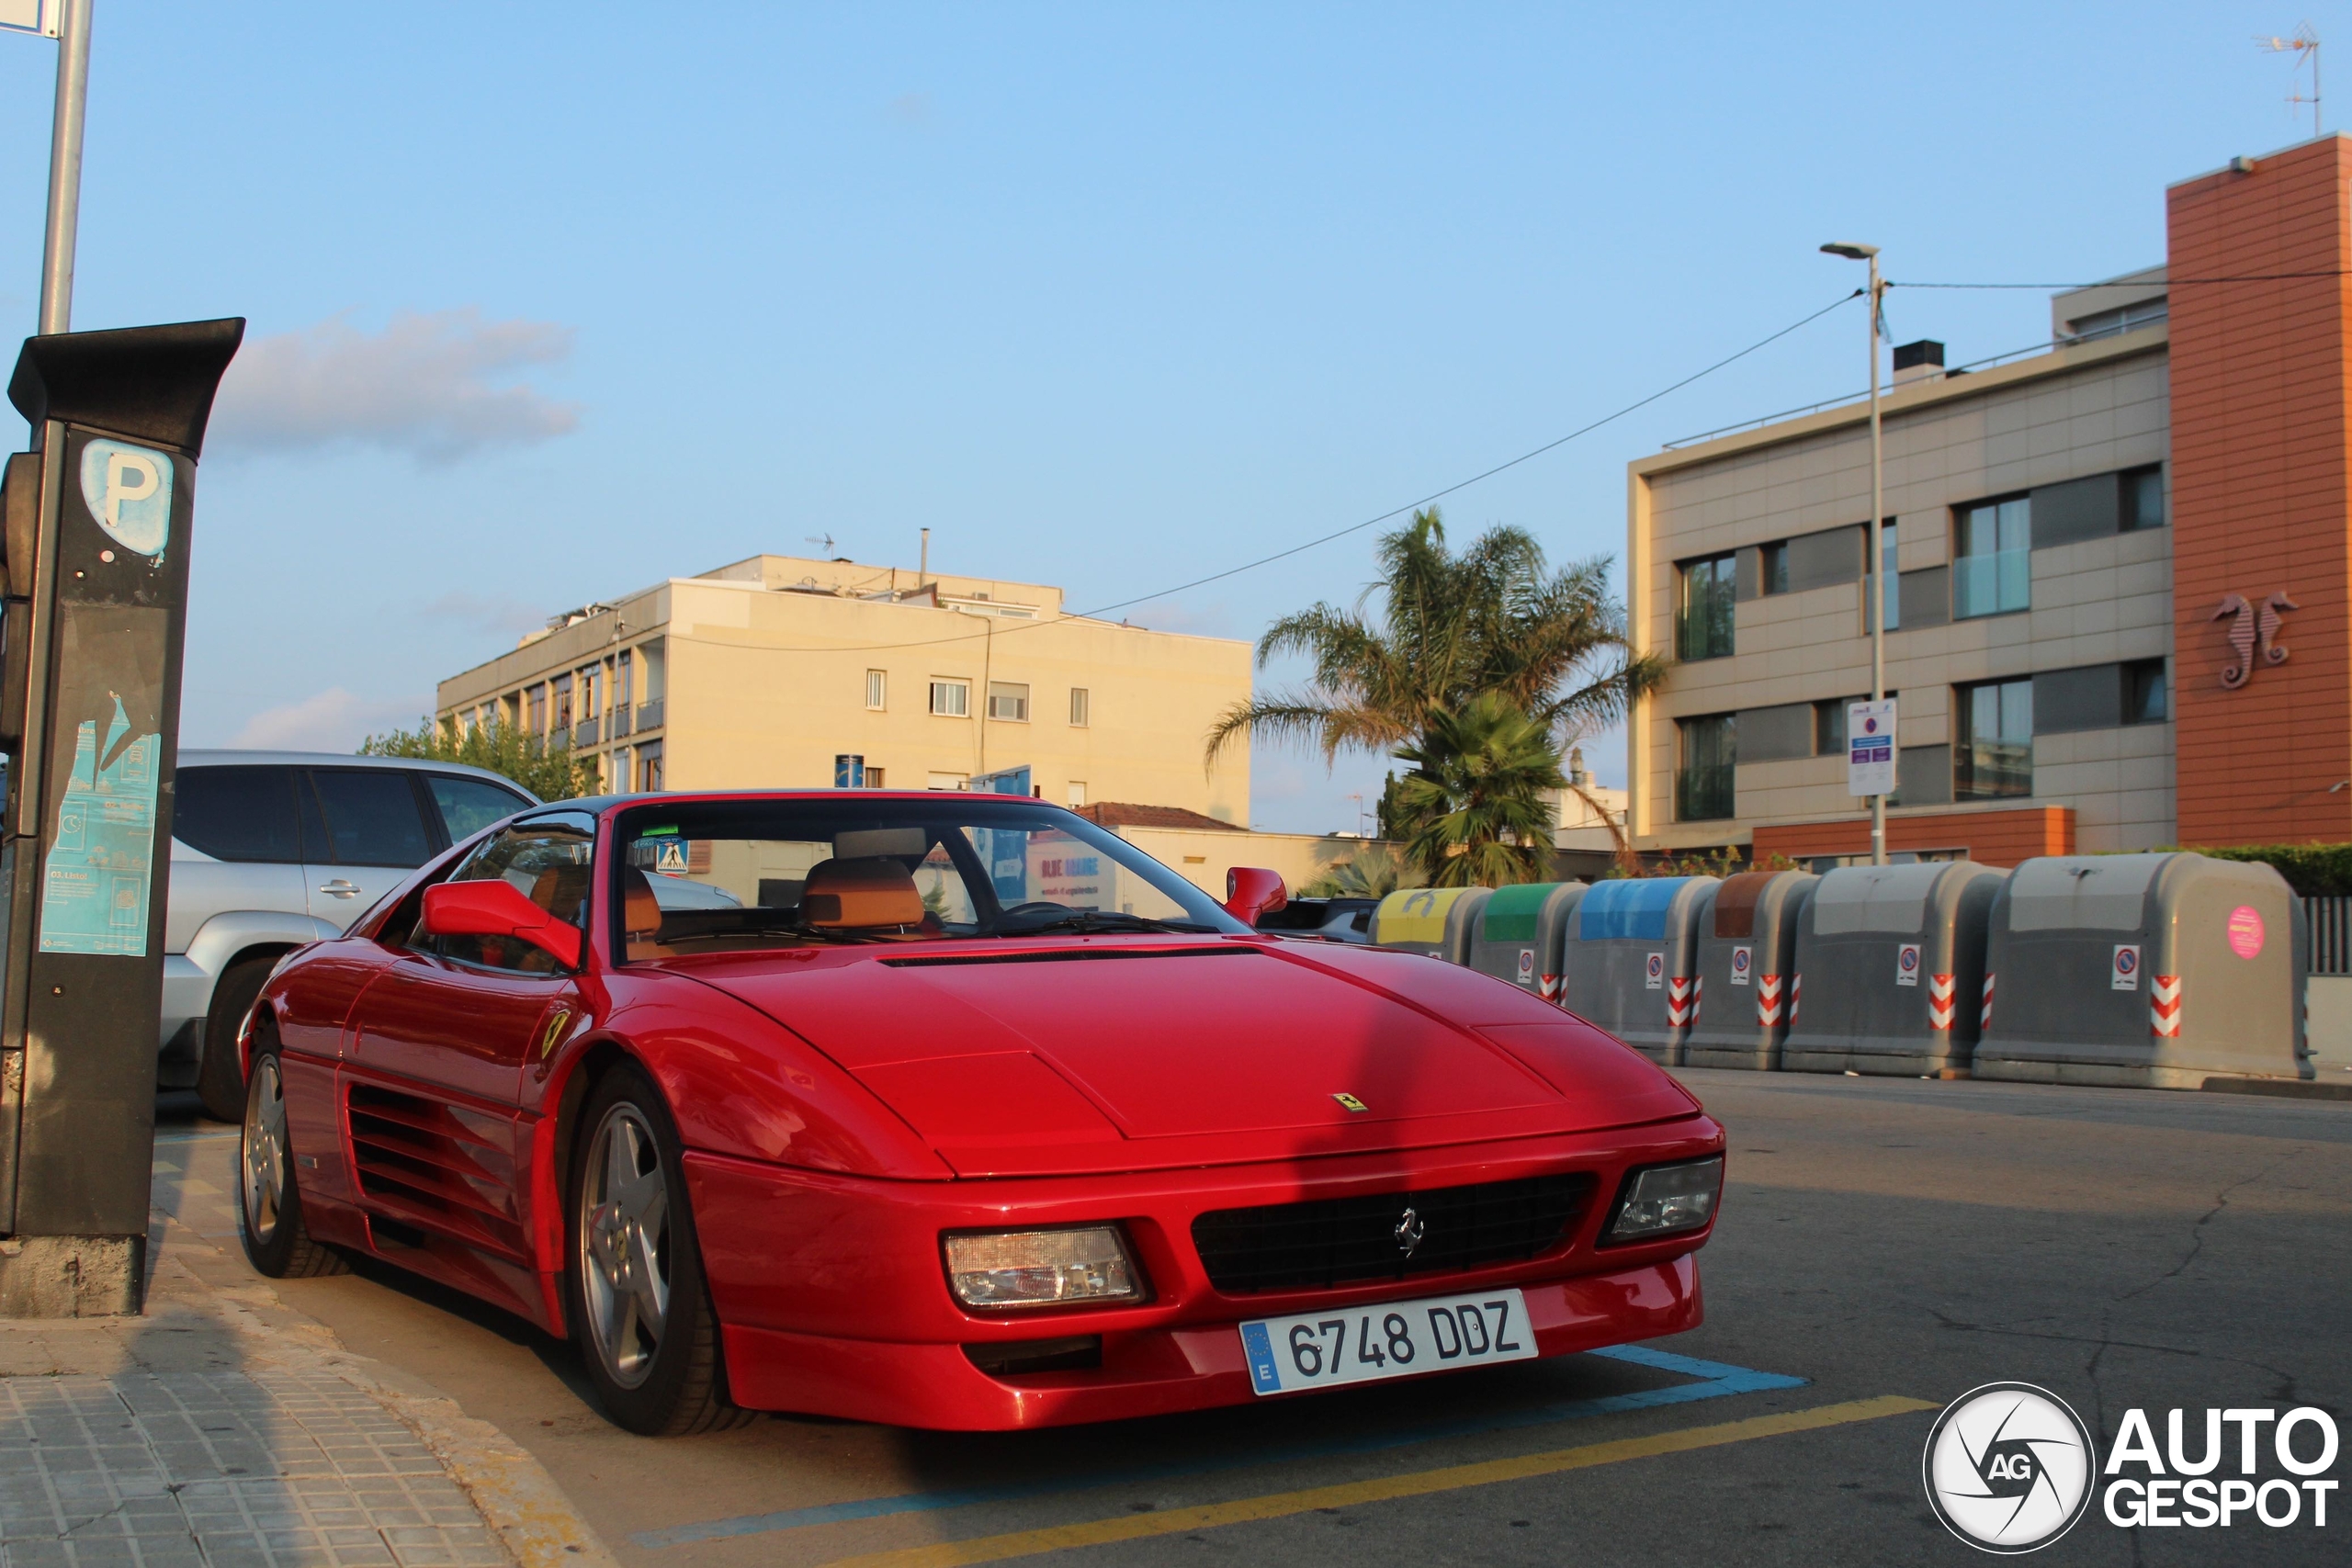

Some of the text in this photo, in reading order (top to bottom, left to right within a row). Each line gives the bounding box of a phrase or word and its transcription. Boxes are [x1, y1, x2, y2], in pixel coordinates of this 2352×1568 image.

[106, 454, 159, 526] P
[1259, 1364, 1272, 1380] E
[1289, 1301, 1521, 1377] 6748 DDZ
